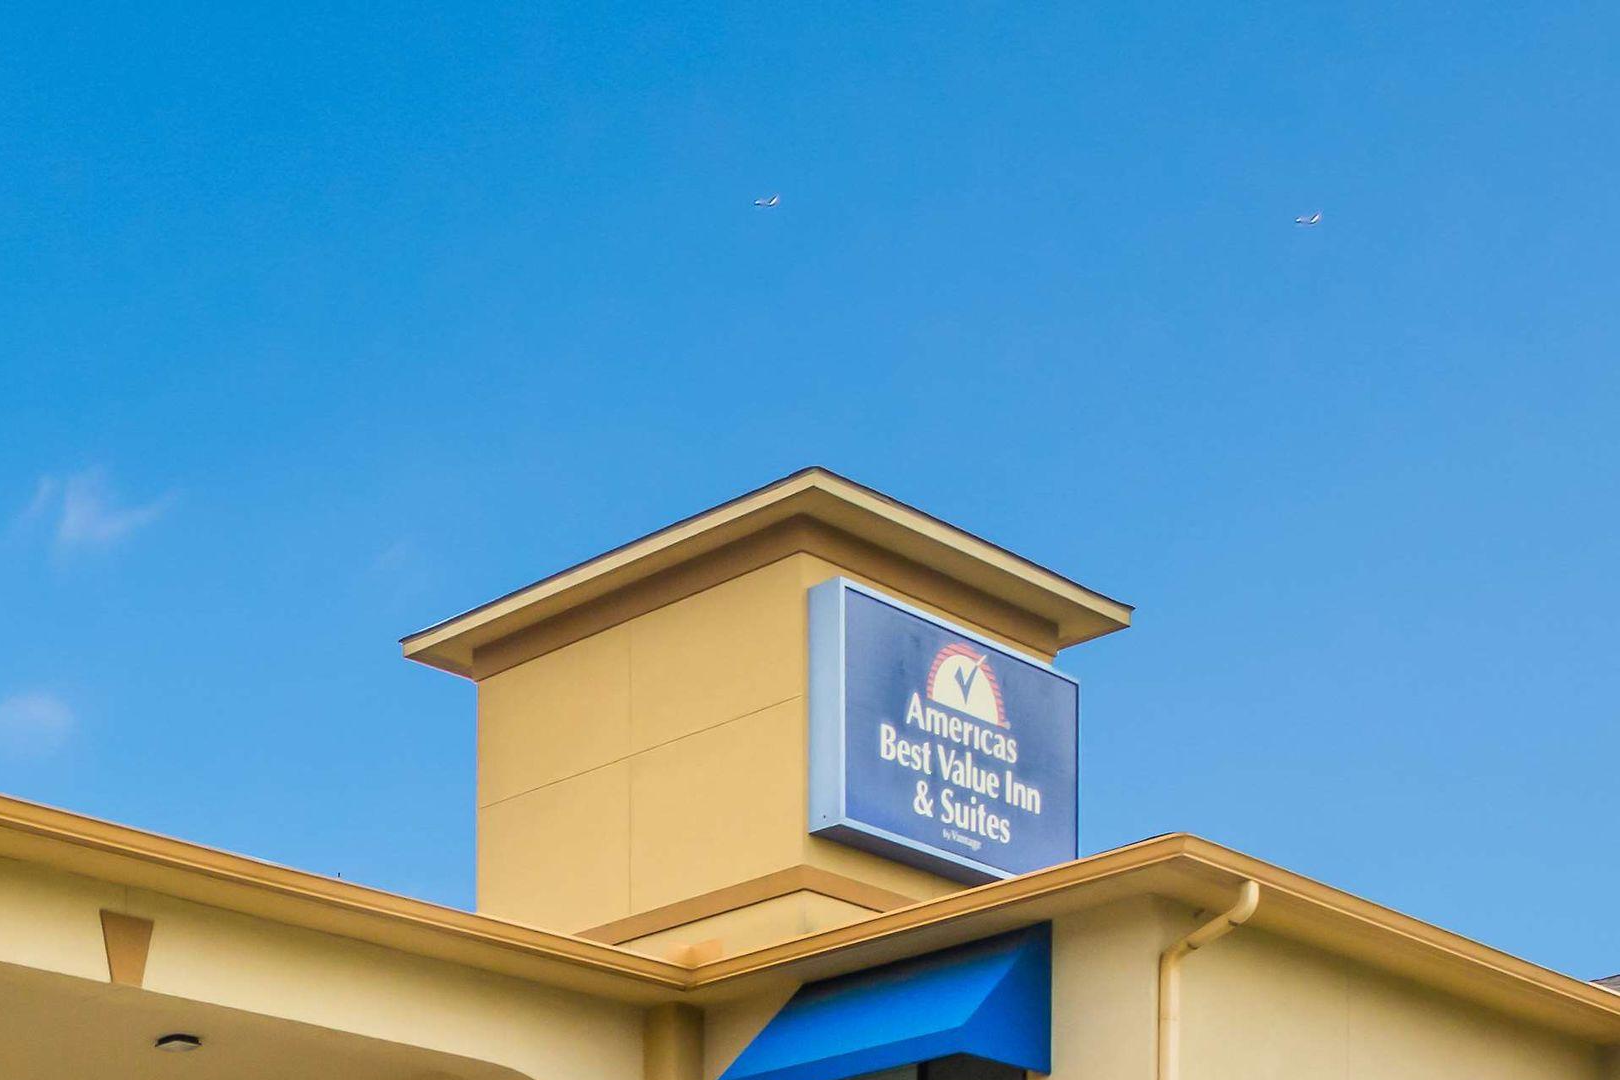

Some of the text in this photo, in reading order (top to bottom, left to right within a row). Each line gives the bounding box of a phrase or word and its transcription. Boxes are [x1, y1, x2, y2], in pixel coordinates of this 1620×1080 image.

[906, 692, 1018, 764] Americas
[880, 723, 1041, 815] Best Value Inn
[913, 780, 933, 818] &
[940, 788, 1011, 844] Suites
